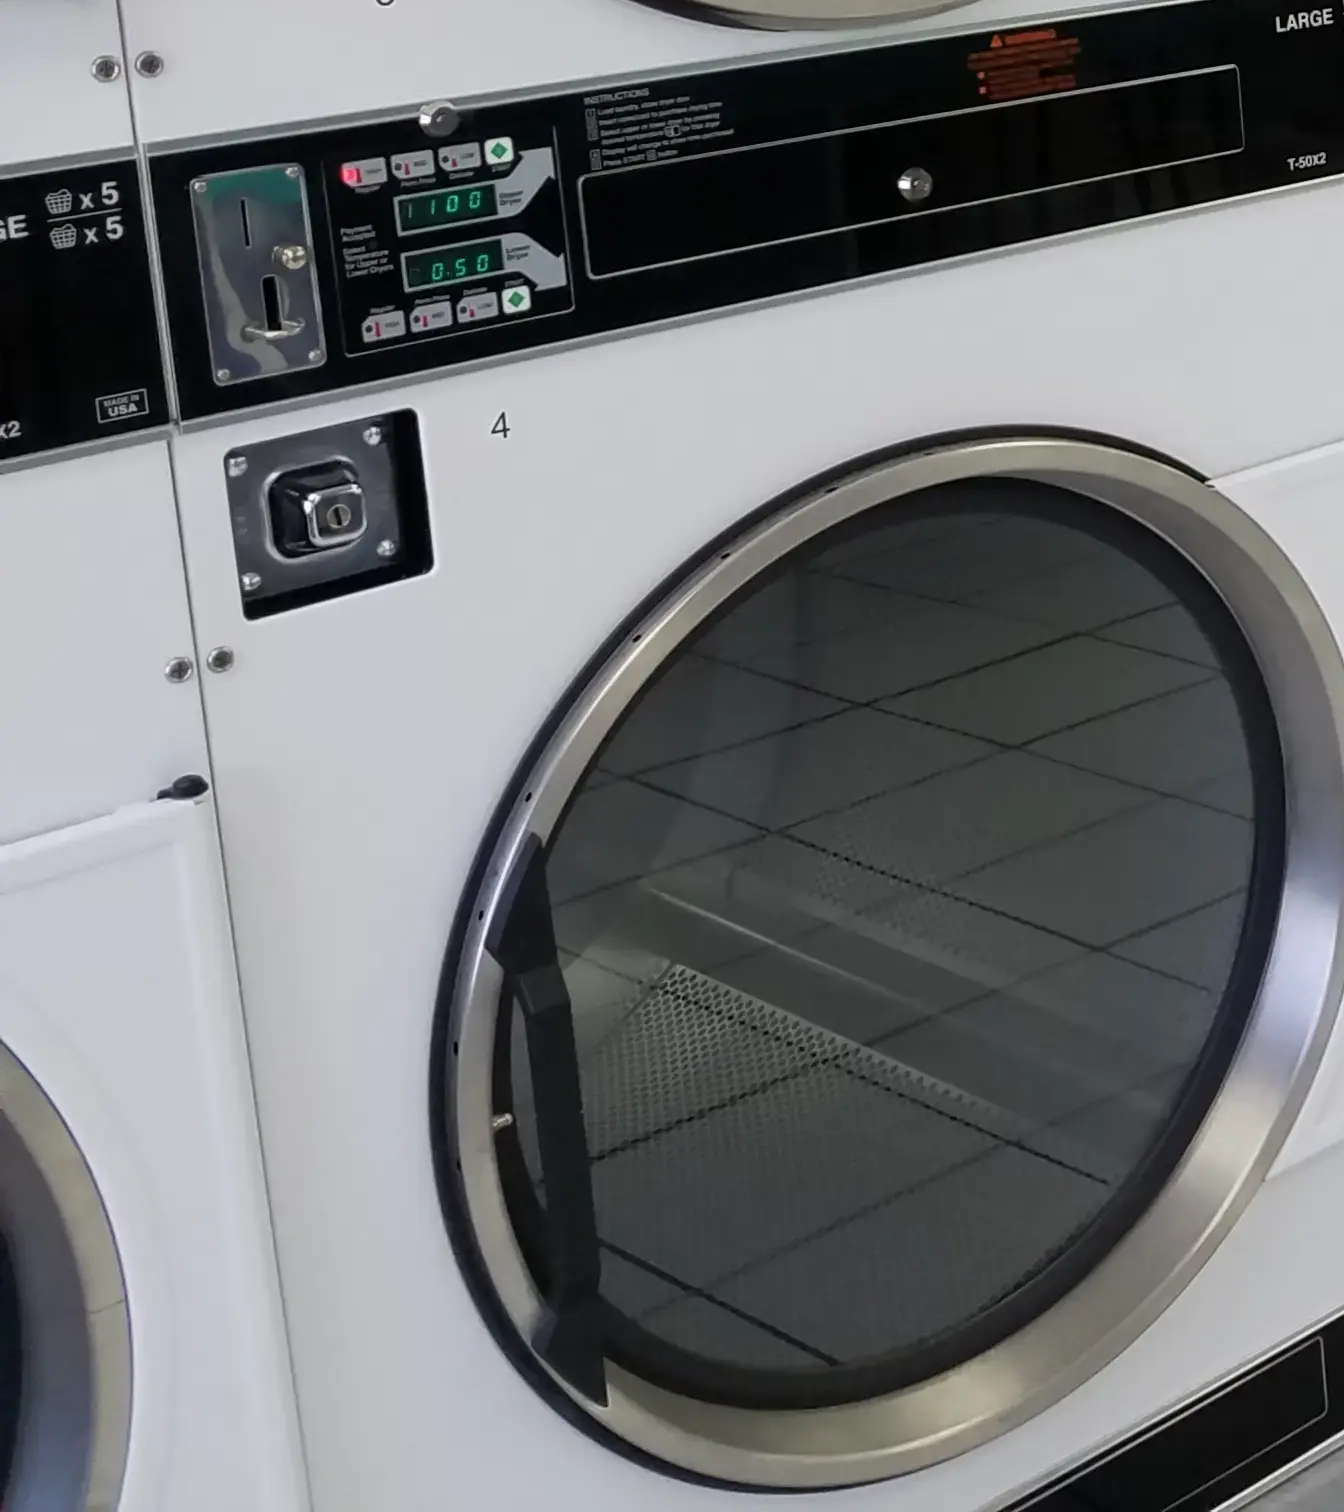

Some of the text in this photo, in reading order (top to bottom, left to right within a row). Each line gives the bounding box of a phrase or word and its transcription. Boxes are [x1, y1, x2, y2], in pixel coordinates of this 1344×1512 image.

[1275, 8, 1334, 33] LARGE
[1287, 152, 1326, 172] T-50X2
[79, 181, 119, 210] x 5
[0, 215, 29, 241] E
[83, 216, 124, 245] x 5
[104, 395, 129, 408] MADE
[108, 404, 138, 418] USA
[490, 412, 512, 439] 4
